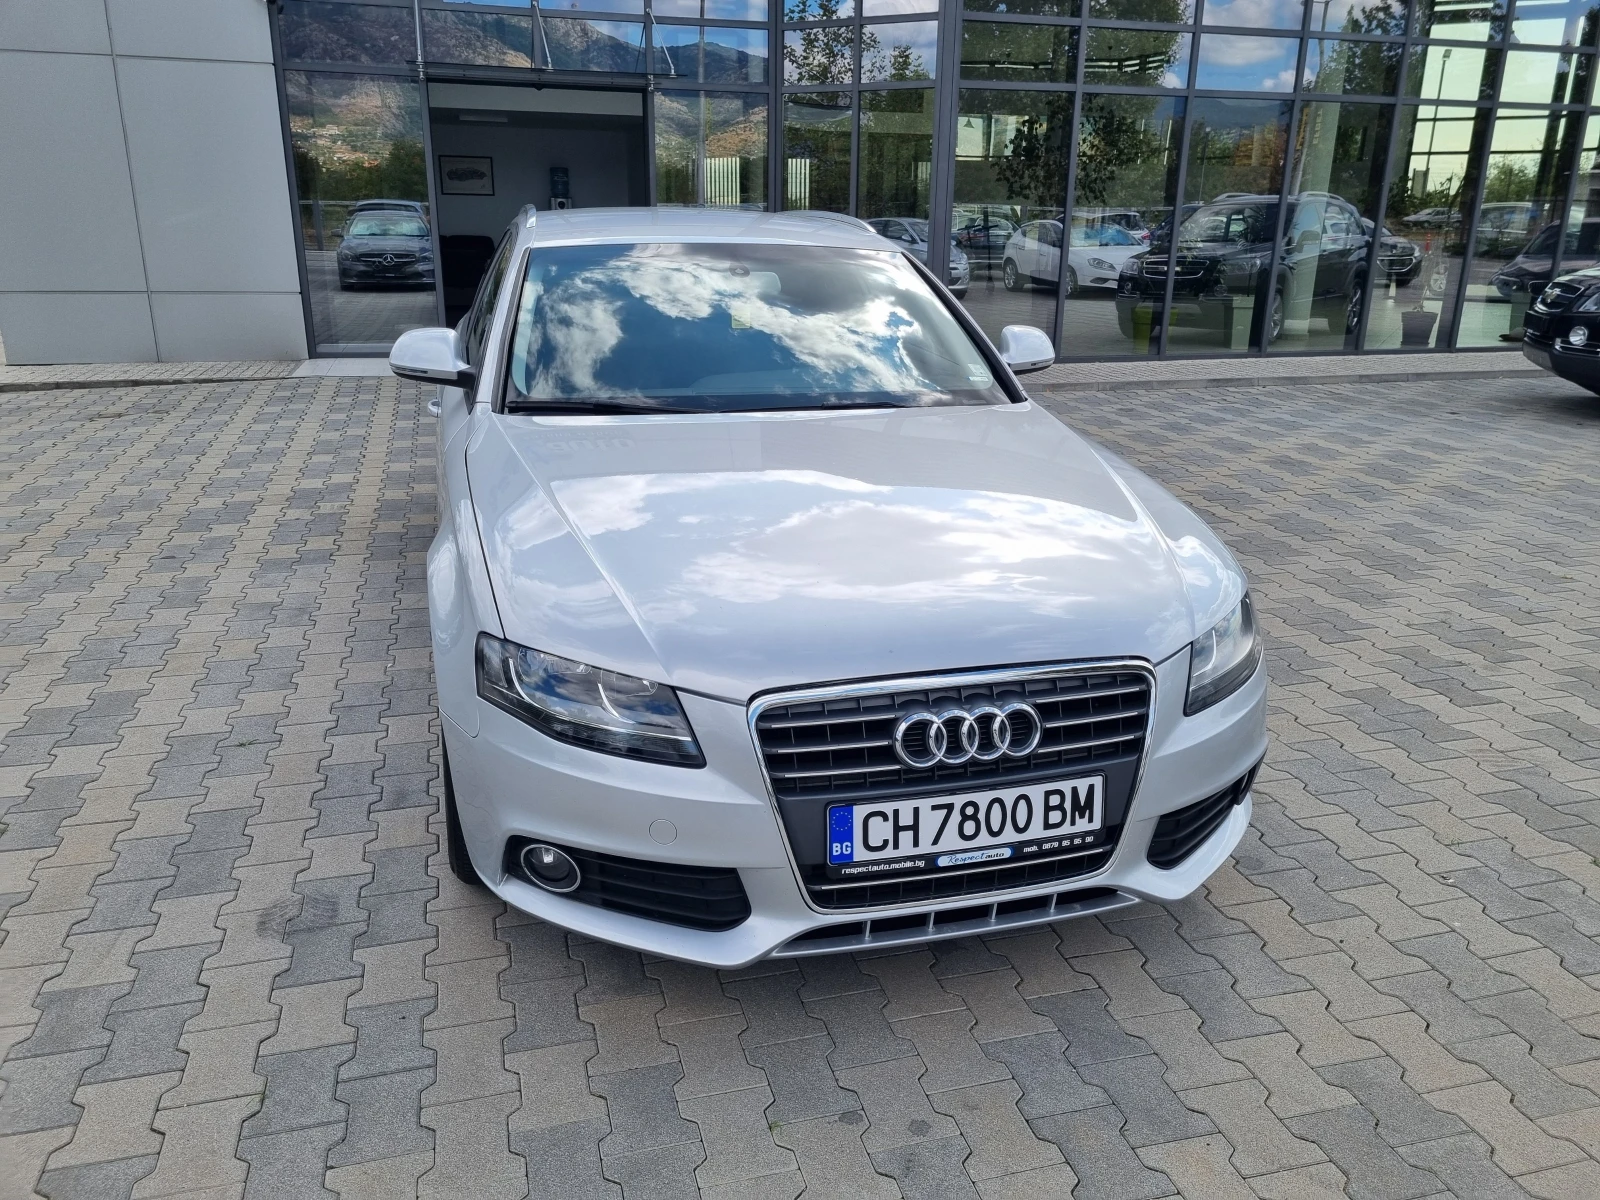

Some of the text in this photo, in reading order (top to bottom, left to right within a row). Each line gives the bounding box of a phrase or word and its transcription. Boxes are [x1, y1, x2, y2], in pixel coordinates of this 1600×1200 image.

[862, 783, 1095, 853] CH 7800 BM
[832, 842, 852, 856] BG
[841, 860, 925, 874] respectauto.mobile.bg
